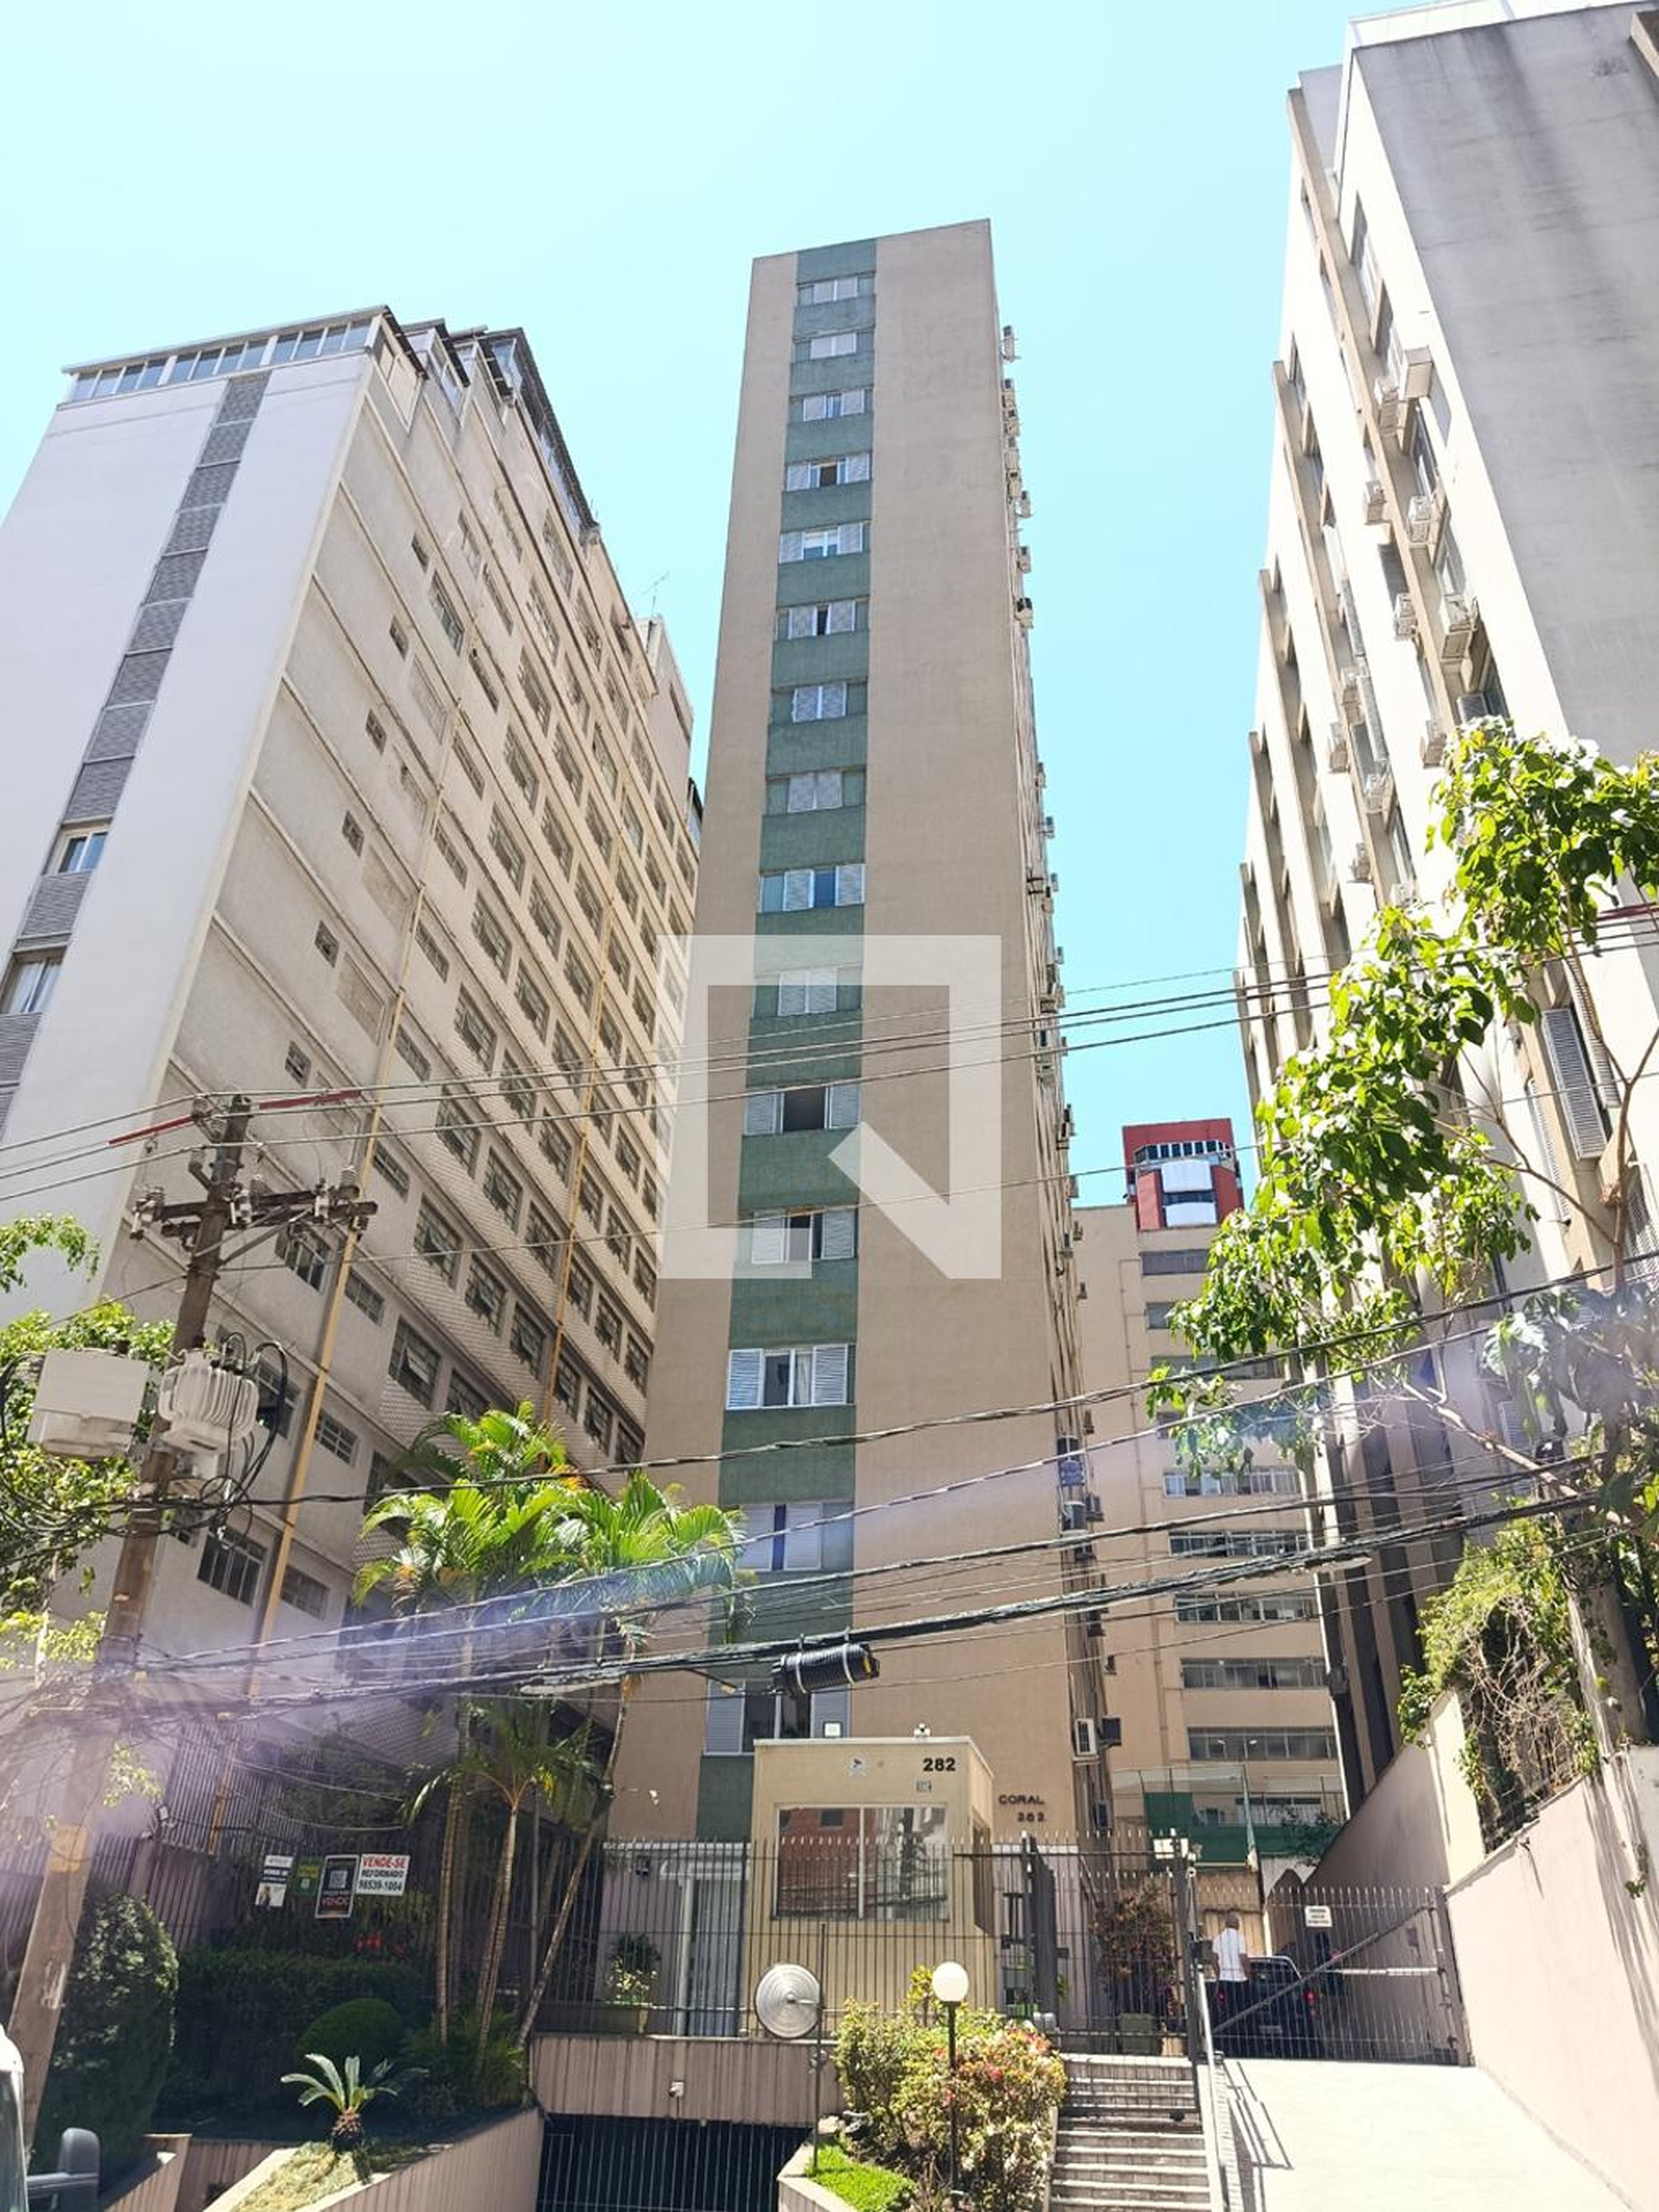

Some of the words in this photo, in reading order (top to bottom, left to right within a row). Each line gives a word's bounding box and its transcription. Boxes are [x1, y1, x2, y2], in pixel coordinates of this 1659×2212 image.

[923, 1757, 956, 1772] 282
[998, 1795, 1045, 1805] CORAL
[1018, 1812, 1045, 1822] 282
[362, 1857, 406, 1868] VENDE-SE
